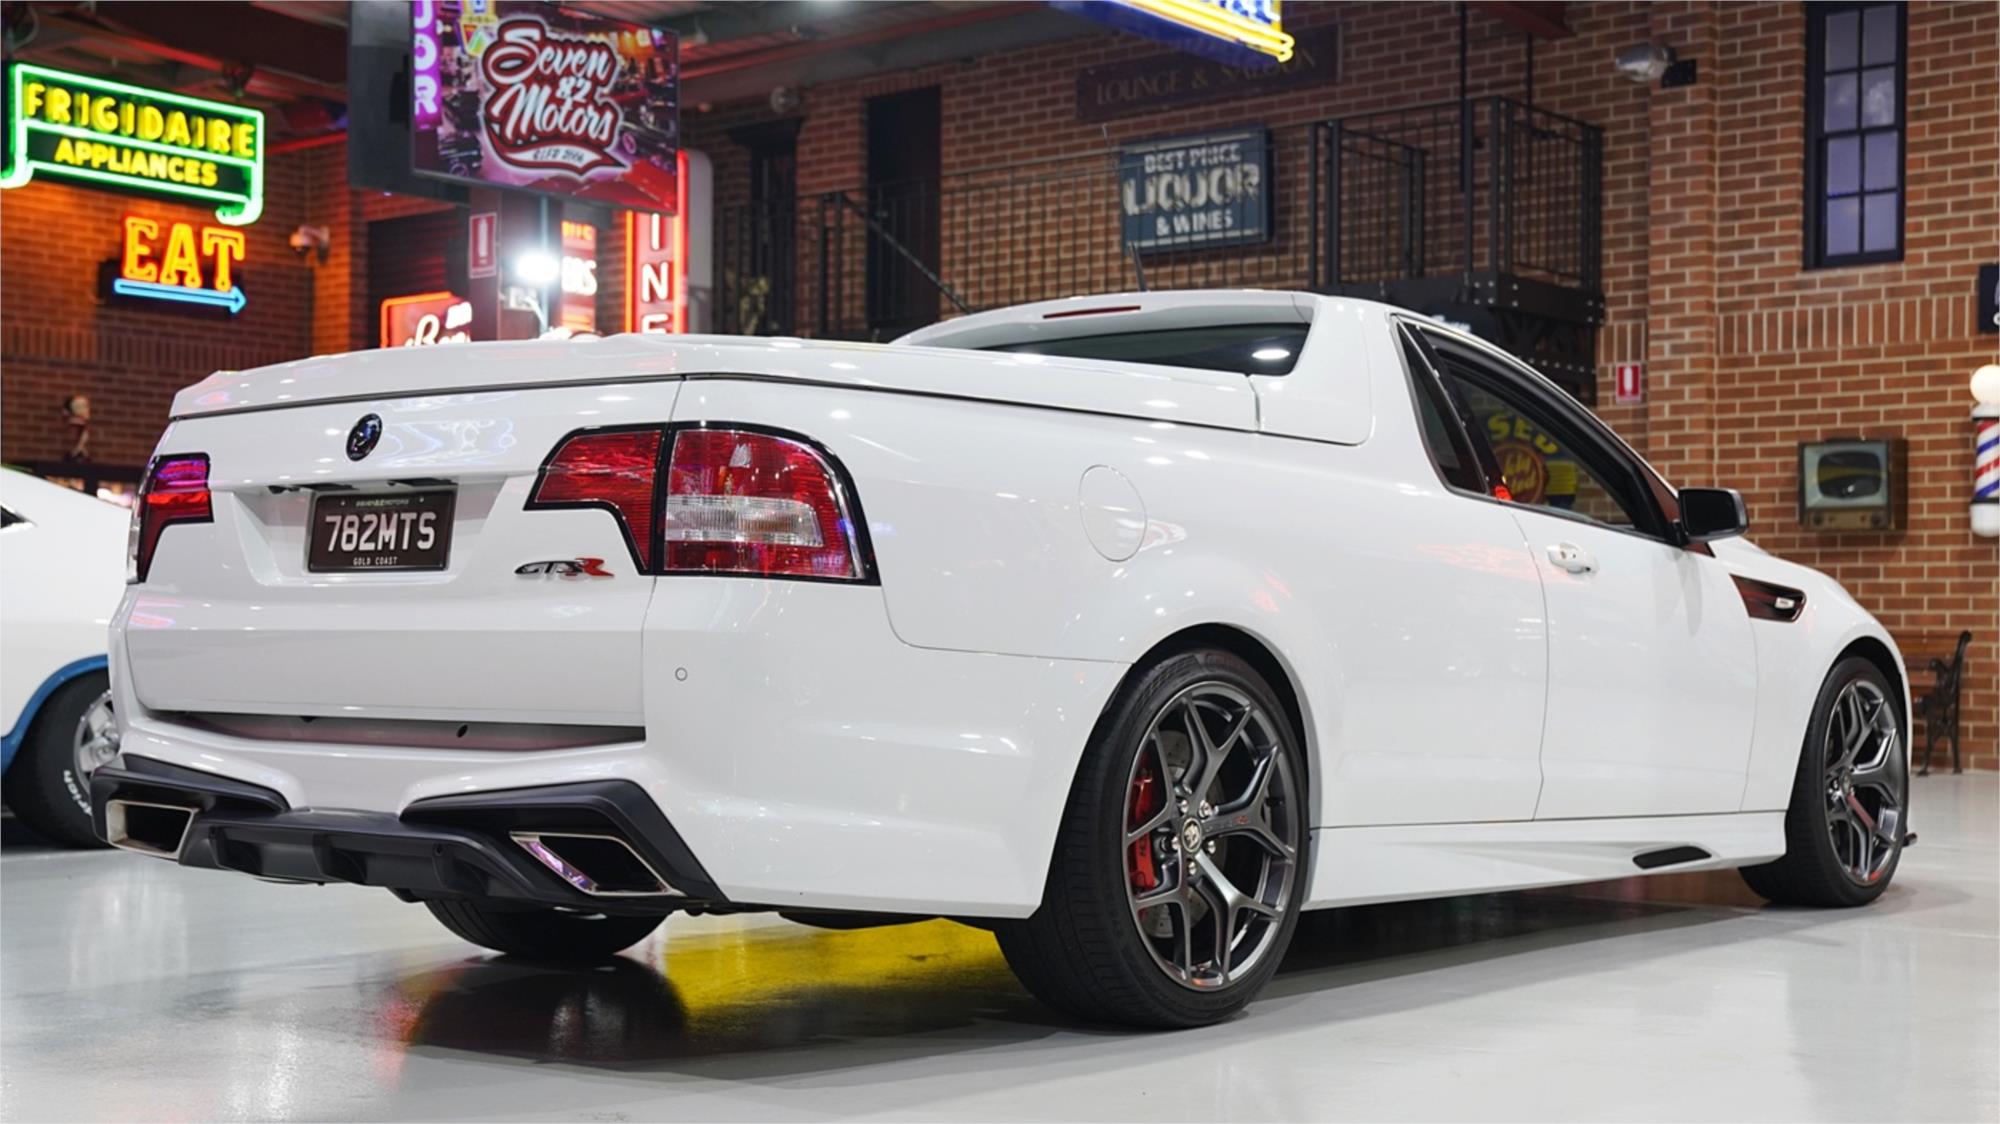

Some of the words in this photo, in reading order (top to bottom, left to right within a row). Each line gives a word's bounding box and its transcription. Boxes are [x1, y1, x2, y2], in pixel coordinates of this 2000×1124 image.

[488, 27, 613, 84] Seven
[555, 76, 592, 103] 82
[1097, 70, 1183, 106] LOUNGE
[1191, 66, 1208, 89] &
[24, 82, 255, 158] FRIGIDAIRE
[491, 82, 614, 141] Motors
[54, 138, 218, 187] APPLIANCES
[1144, 150, 1187, 174] BEST
[1190, 143, 1242, 167] PRICE
[1123, 163, 1260, 217] LIQUOR
[1156, 216, 1170, 237] &
[1173, 209, 1234, 235] WINES
[122, 215, 245, 292] EAT
[325, 511, 438, 552] 782MTS
[352, 557, 371, 566] GOLD
[375, 556, 398, 566] COAST
